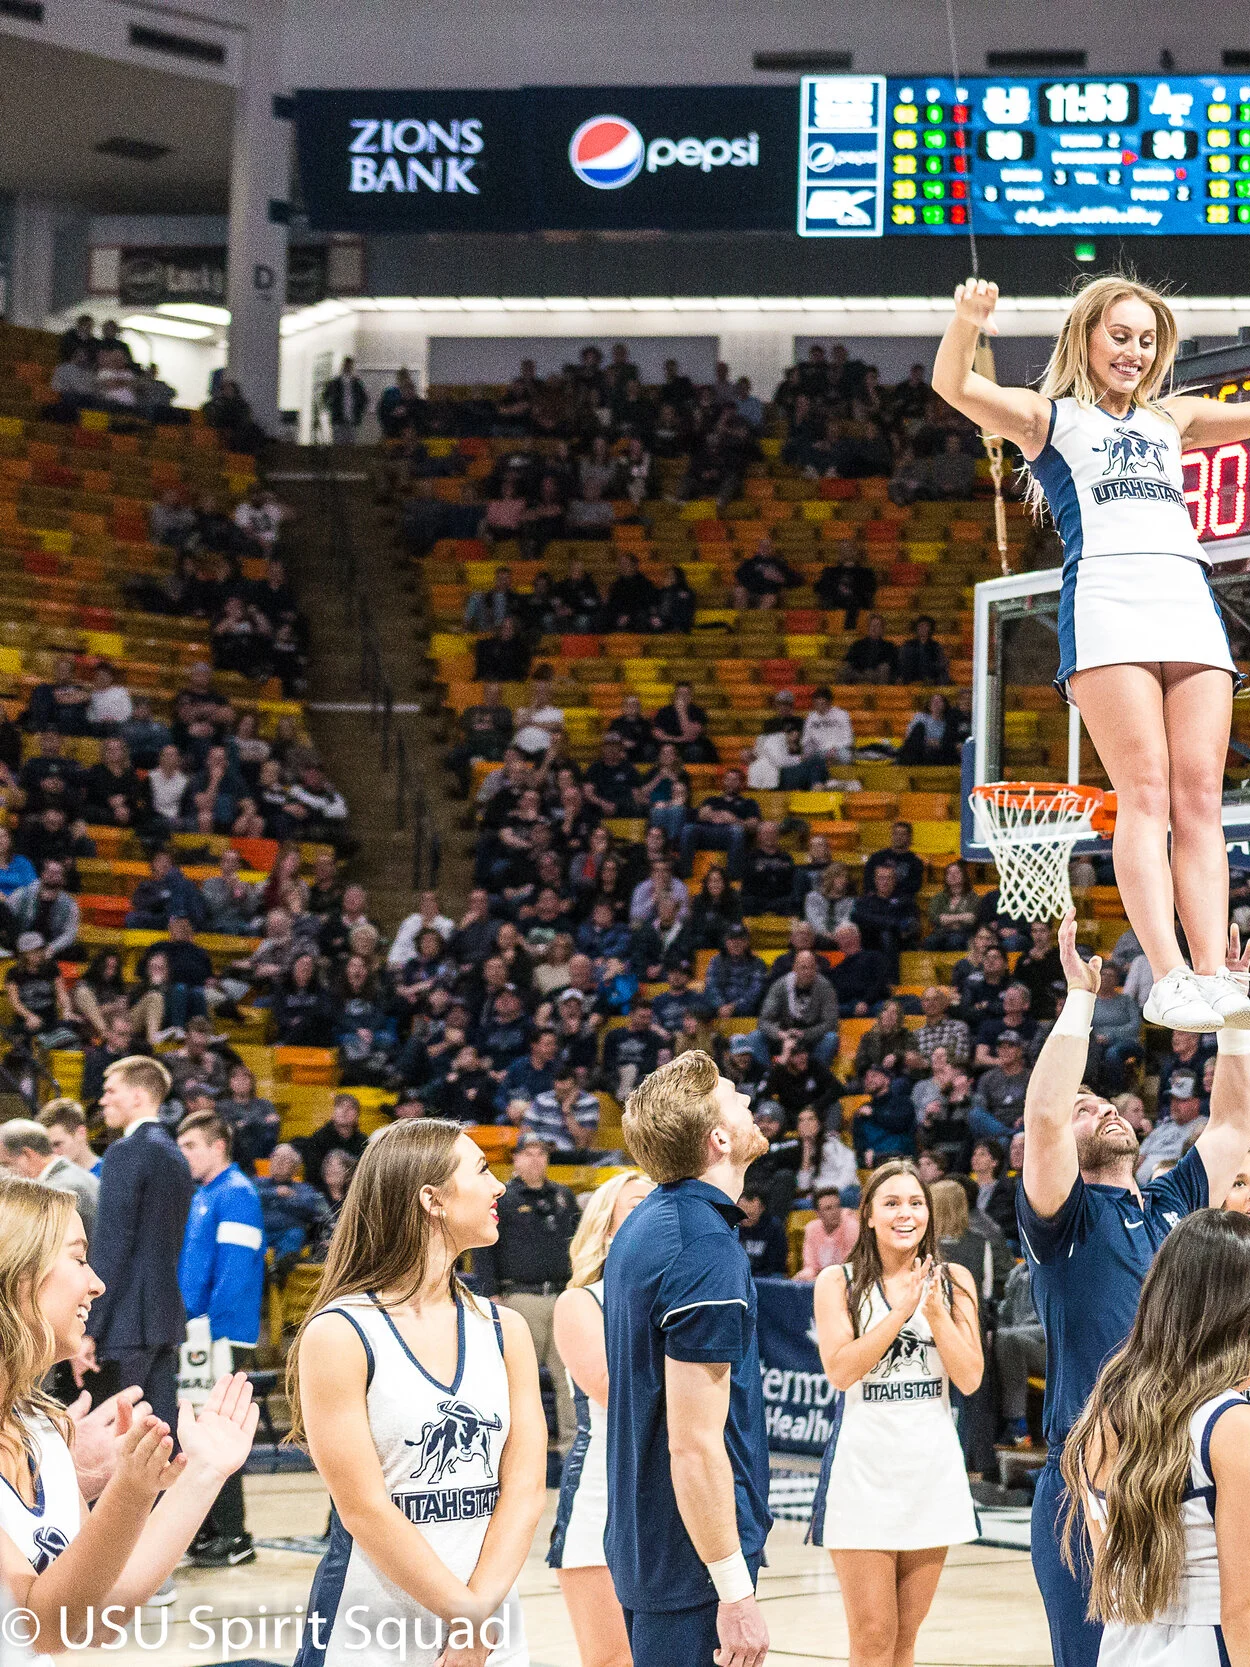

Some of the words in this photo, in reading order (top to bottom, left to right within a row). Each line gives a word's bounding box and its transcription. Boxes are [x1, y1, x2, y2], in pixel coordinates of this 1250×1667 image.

[348, 118, 484, 155] ZIONS
[646, 132, 760, 173] pepsi
[348, 157, 482, 195] BANK
[255, 263, 274, 290] D
[1092, 477, 1144, 505] UTAH
[862, 1381, 902, 1403] UTAH
[903, 1377, 942, 1402] STATE
